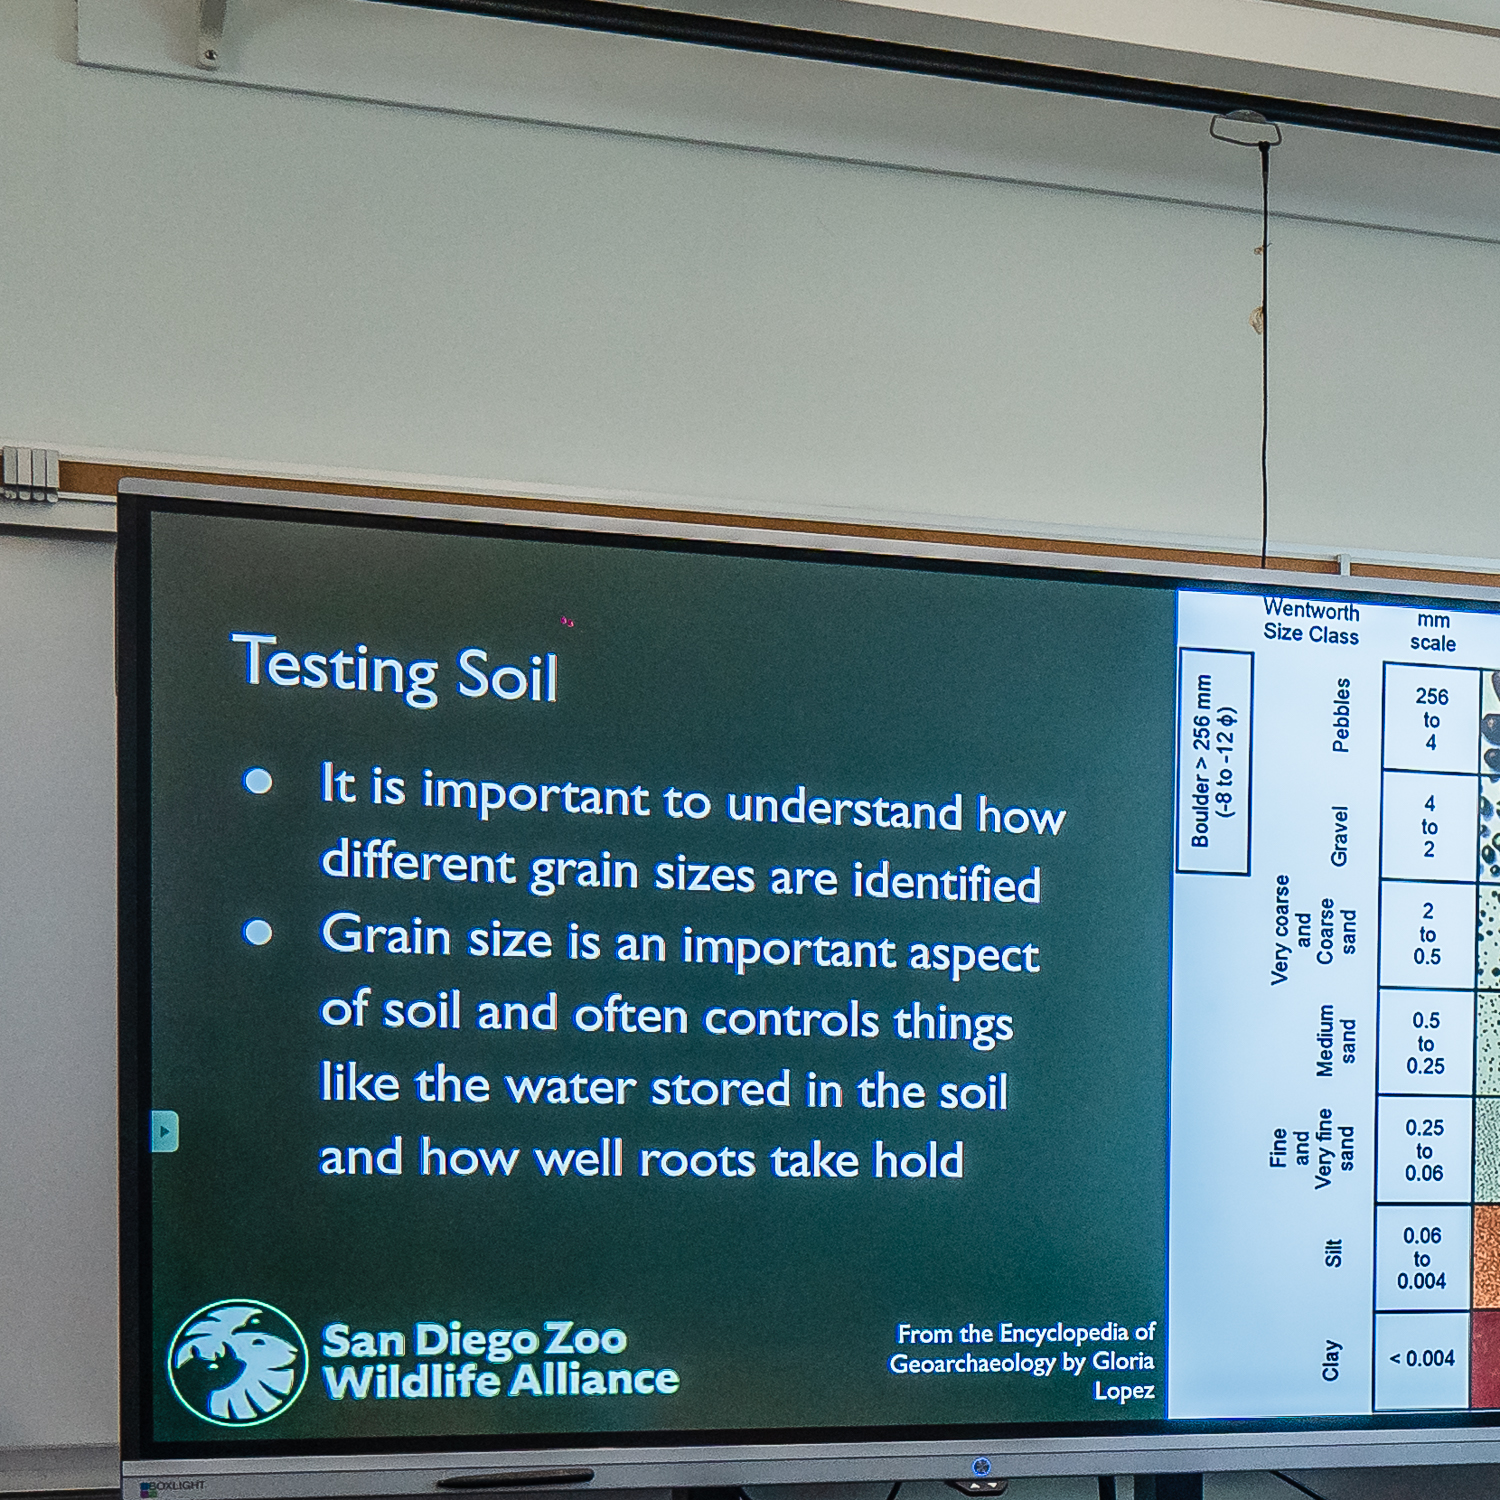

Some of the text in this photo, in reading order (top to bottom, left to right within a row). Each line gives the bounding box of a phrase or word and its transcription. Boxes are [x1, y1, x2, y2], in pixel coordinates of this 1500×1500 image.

[1263, 596, 1360, 622] Wentworth
[1418, 614, 1449, 628] mm
[1264, 623, 1359, 645] Size Class
[1411, 635, 1456, 652] scale
[232, 634, 557, 709] Testing Soil
[1197, 674, 1211, 709] mm
[1416, 688, 1448, 705] 256
[1333, 679, 1350, 752] Pebbles
[1424, 712, 1440, 728] to
[1193, 715, 1210, 750] 256
[1426, 734, 1436, 750] 4
[1216, 732, 1233, 763] -12
[1216, 769, 1232, 786] to
[324, 762, 1066, 835] It is important to understand how
[1192, 774, 1209, 847] Boulder
[1425, 795, 1435, 811] 4
[1331, 807, 1348, 867] Gravel
[1422, 819, 1438, 834] to
[1424, 841, 1434, 857] 2
[323, 838, 1040, 903] different grain sizes are identified
[1423, 903, 1433, 919] 2
[1271, 875, 1292, 985] Very coarse
[1295, 913, 1311, 947] and
[1317, 898, 1334, 964] Coarse
[1340, 910, 1356, 954] sand
[1420, 927, 1436, 942] to
[323, 913, 1040, 981] Grain size is an important aspect
[1414, 948, 1440, 964] 0.5
[323, 987, 1013, 1050] of soil and often controls things
[1413, 1012, 1440, 1028] 0.5
[1317, 1005, 1333, 1076] Medium
[1339, 1020, 1355, 1063] sand
[1418, 1036, 1434, 1052] to
[1407, 1057, 1444, 1074] 0.25
[324, 1061, 1007, 1109] like the water stored in the soil
[1406, 1119, 1444, 1136] 0.25
[322, 1136, 962, 1177] and how well roots take hold
[1270, 1129, 1287, 1167] Fine
[1293, 1132, 1309, 1165] and
[1315, 1109, 1335, 1189] Very fine
[1338, 1127, 1354, 1171] sand
[1417, 1143, 1432, 1159] to
[1406, 1165, 1443, 1181] 0.06
[1404, 1227, 1441, 1244] 0.06
[1325, 1240, 1342, 1267] Silt
[1414, 1251, 1430, 1267] to
[1398, 1272, 1446, 1289] 0.004
[324, 1321, 627, 1362] San Diego Zoo
[899, 1321, 1157, 1347] From the Encyclopedia of
[890, 1351, 1155, 1376] Geoarchaeology by Gloria
[1322, 1340, 1343, 1381] Clay
[1407, 1350, 1455, 1366] 0.004
[323, 1361, 680, 1400] Wildlife Alliance
[1095, 1381, 1155, 1404] Lopez
[149, 1480, 206, 1491] BOXLIGHT
